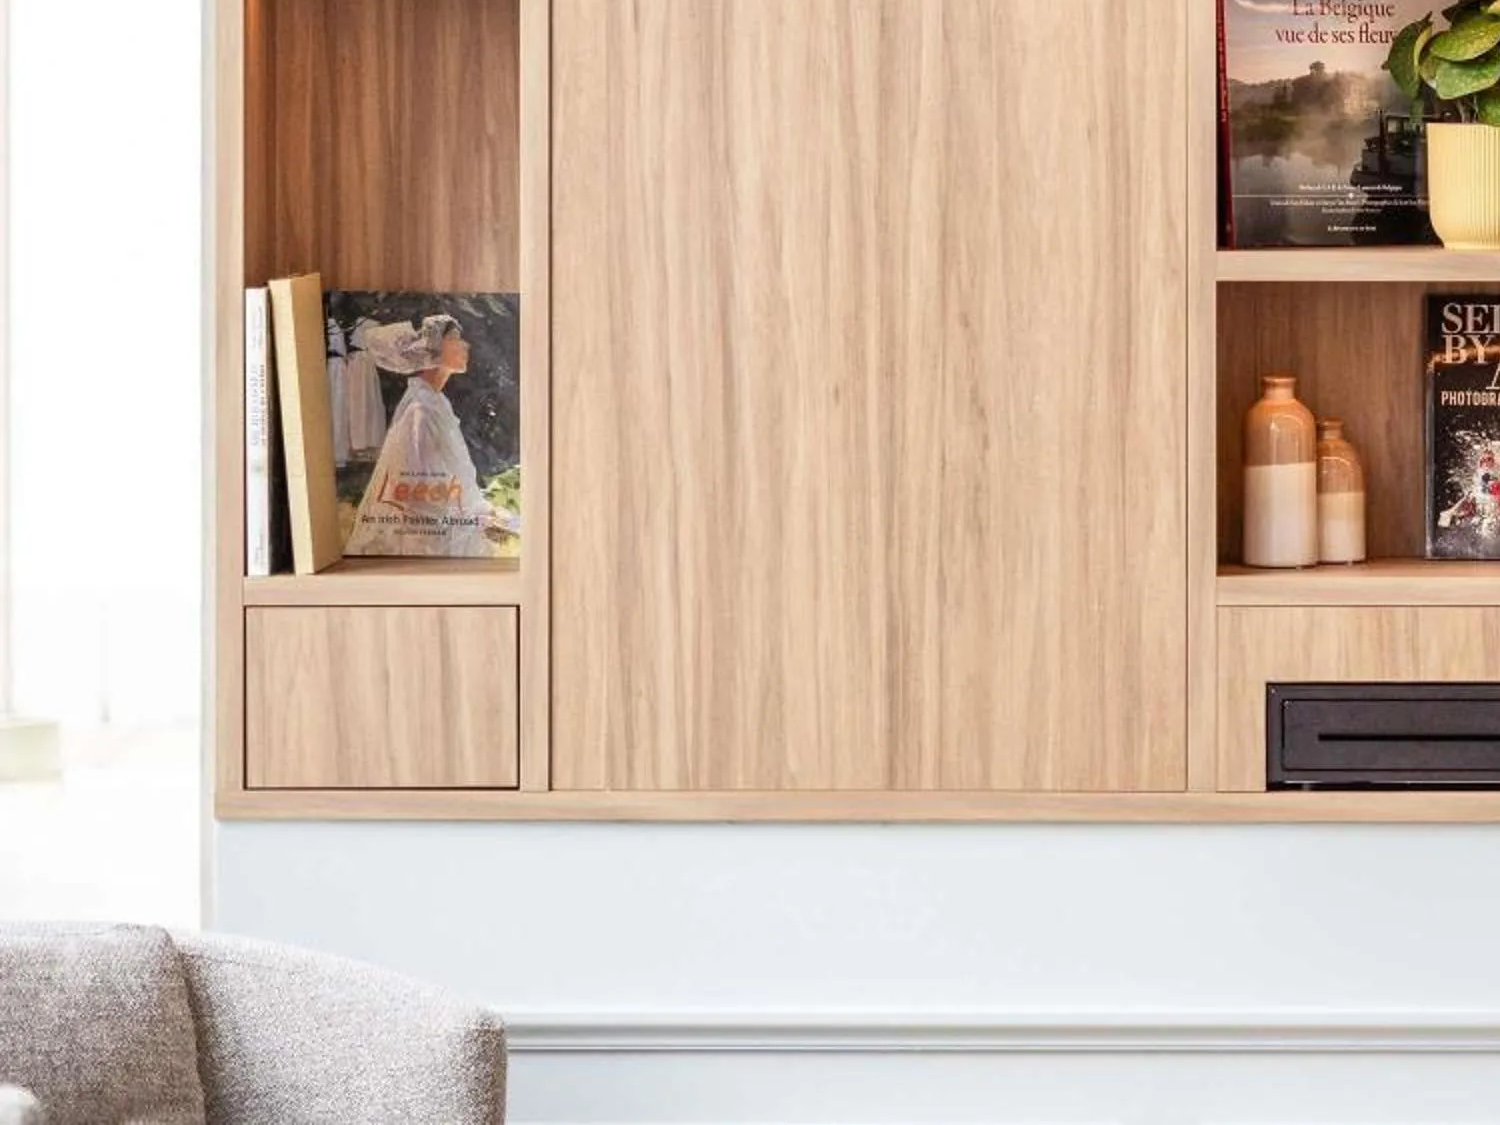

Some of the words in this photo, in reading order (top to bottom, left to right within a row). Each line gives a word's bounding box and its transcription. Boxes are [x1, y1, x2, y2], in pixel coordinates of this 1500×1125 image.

[1275, 29, 1305, 44] vue
[1308, 22, 1330, 44] de
[1332, 29, 1355, 44] ses
[1358, 22, 1397, 44] fleuv
[1442, 334, 1493, 365] BY
